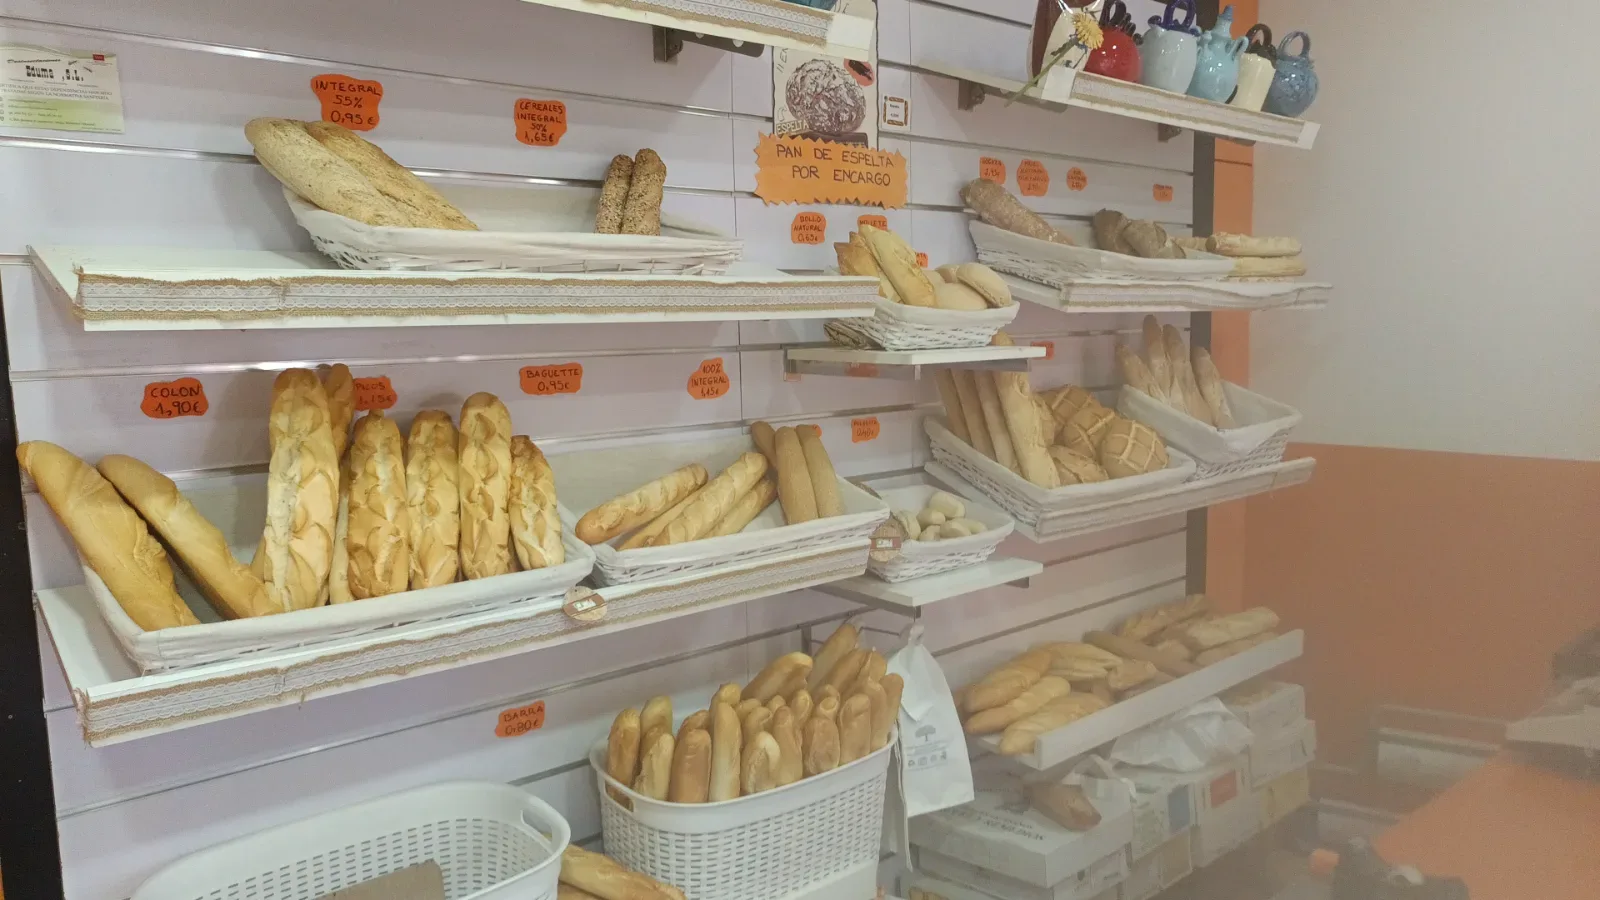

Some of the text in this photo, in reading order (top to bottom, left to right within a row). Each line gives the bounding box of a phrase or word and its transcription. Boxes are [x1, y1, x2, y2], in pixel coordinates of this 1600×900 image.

[26, 65, 54, 78] Eduma
[315, 80, 382, 97] INTEGRAL
[333, 94, 363, 109] 55%
[519, 101, 563, 114] CEREALES
[517, 112, 562, 124] INTEGRAL
[530, 122, 548, 133] 50%
[776, 119, 809, 135] ESPELTA
[524, 130, 555, 143] 1,65€
[775, 143, 894, 168] PAN DE ESPELTA
[792, 165, 891, 186] POR ENCARGO
[799, 215, 822, 224] BOLLO
[793, 224, 823, 232] NATURAL
[526, 368, 580, 379] BAGUETTE
[691, 376, 727, 388] INTEGRAL
[150, 383, 201, 398] COLON
[154, 400, 202, 416] 1,90€
[504, 705, 543, 723] BARRA
